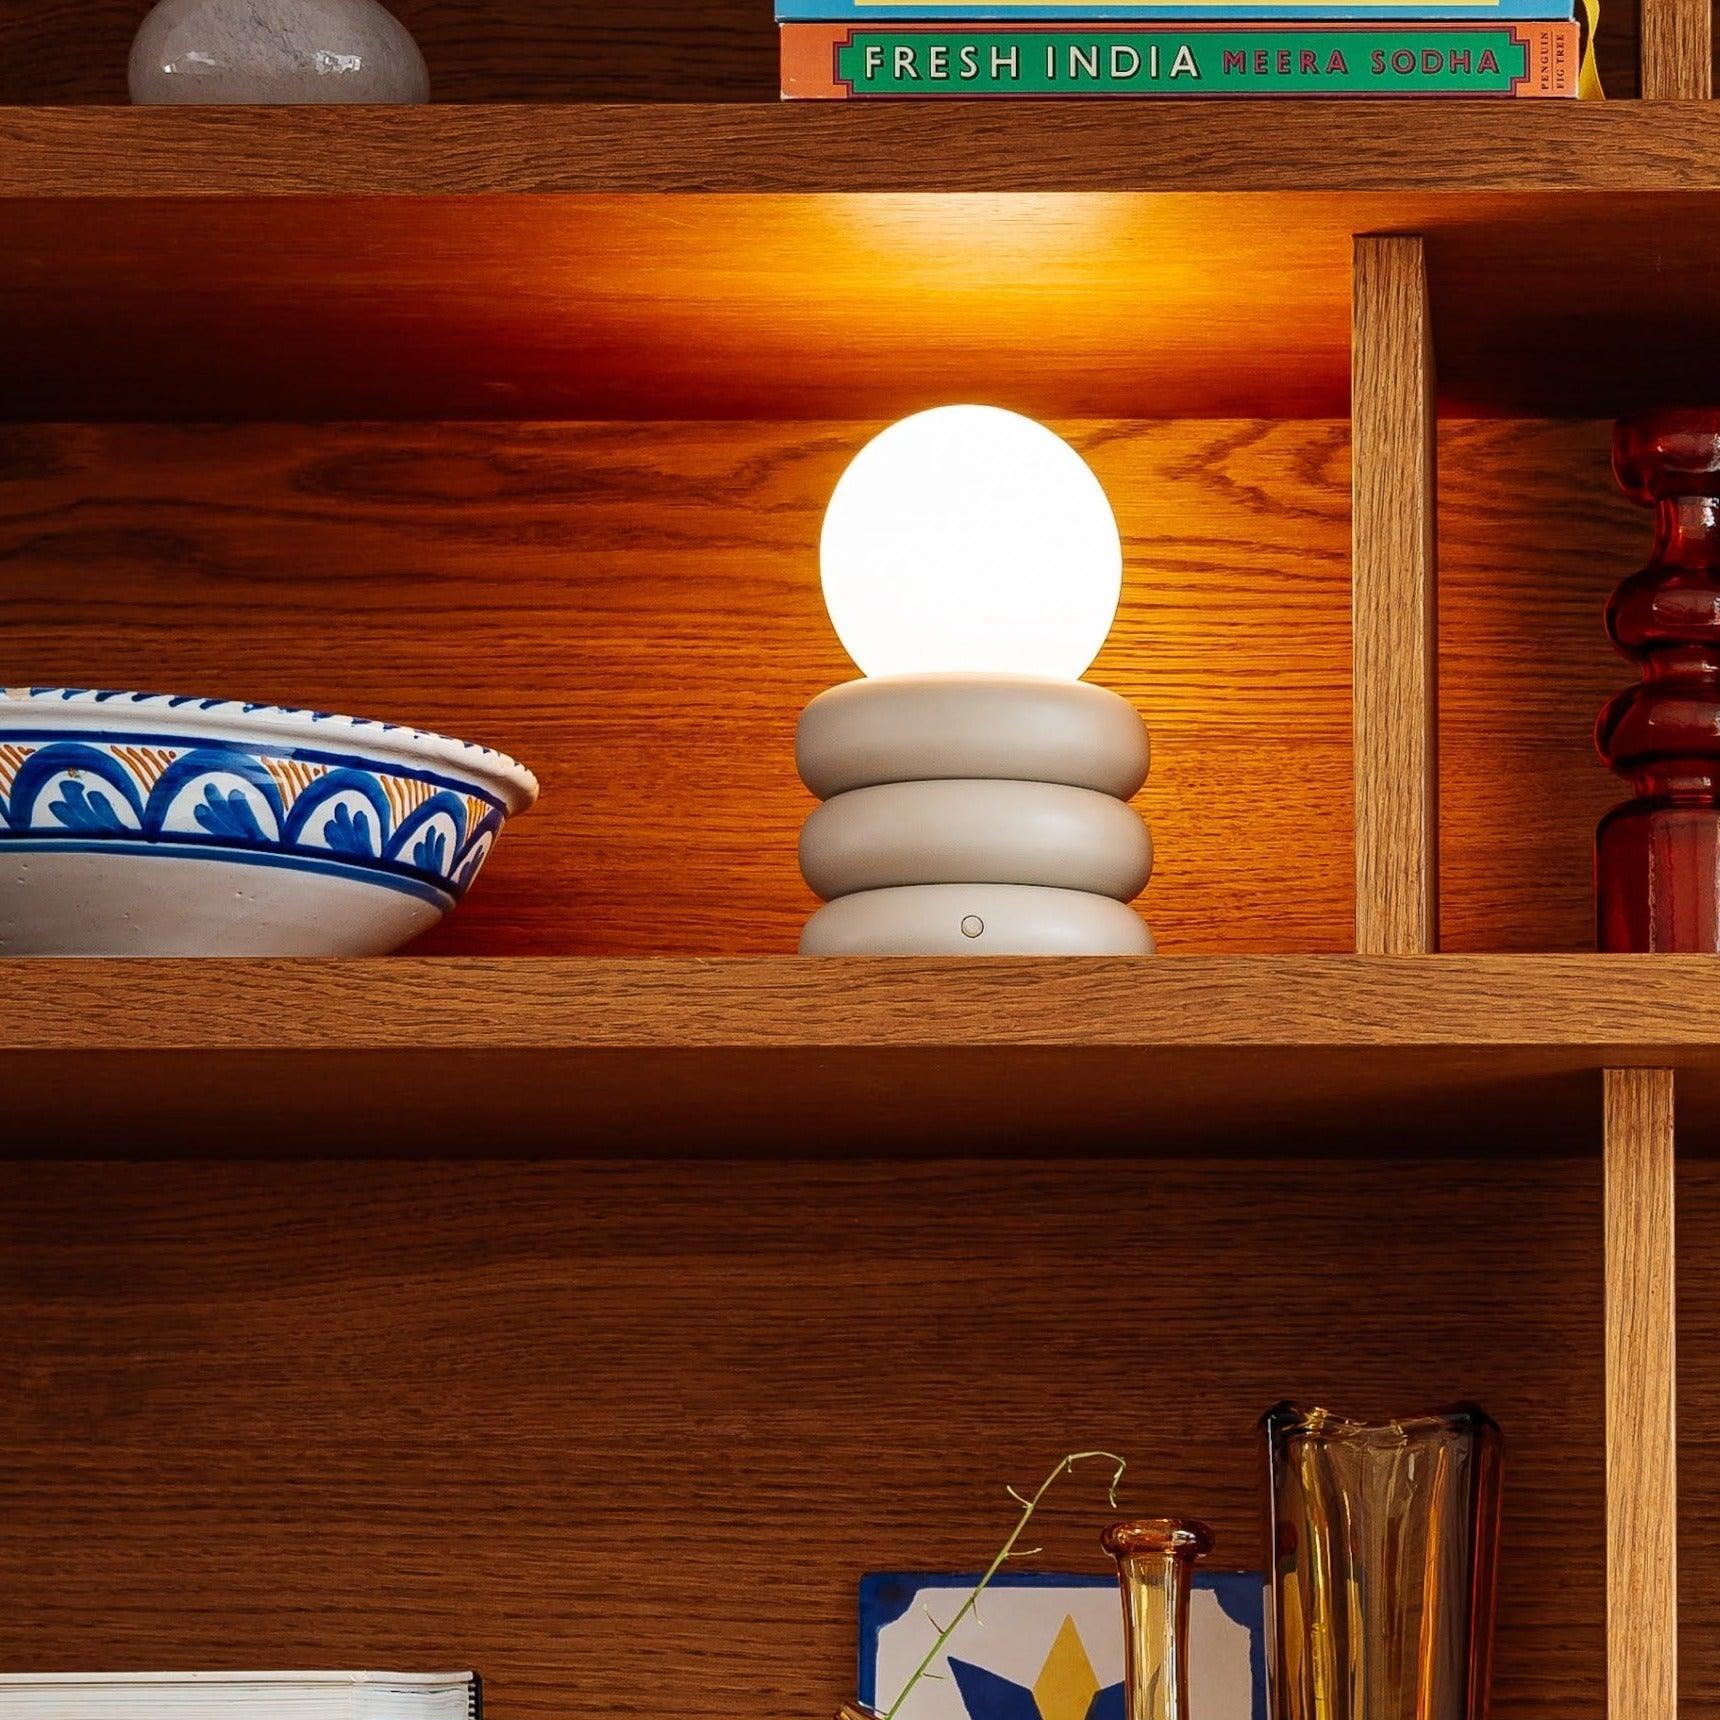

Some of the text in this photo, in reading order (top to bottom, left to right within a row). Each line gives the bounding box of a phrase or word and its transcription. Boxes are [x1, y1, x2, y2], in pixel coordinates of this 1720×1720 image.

[864, 44, 1200, 81] FRESH INDIA
[1222, 47, 1501, 76] MEERA SODHA
[1540, 31, 1549, 90] PENGUIN
[1556, 34, 1565, 89] FIG TREE
